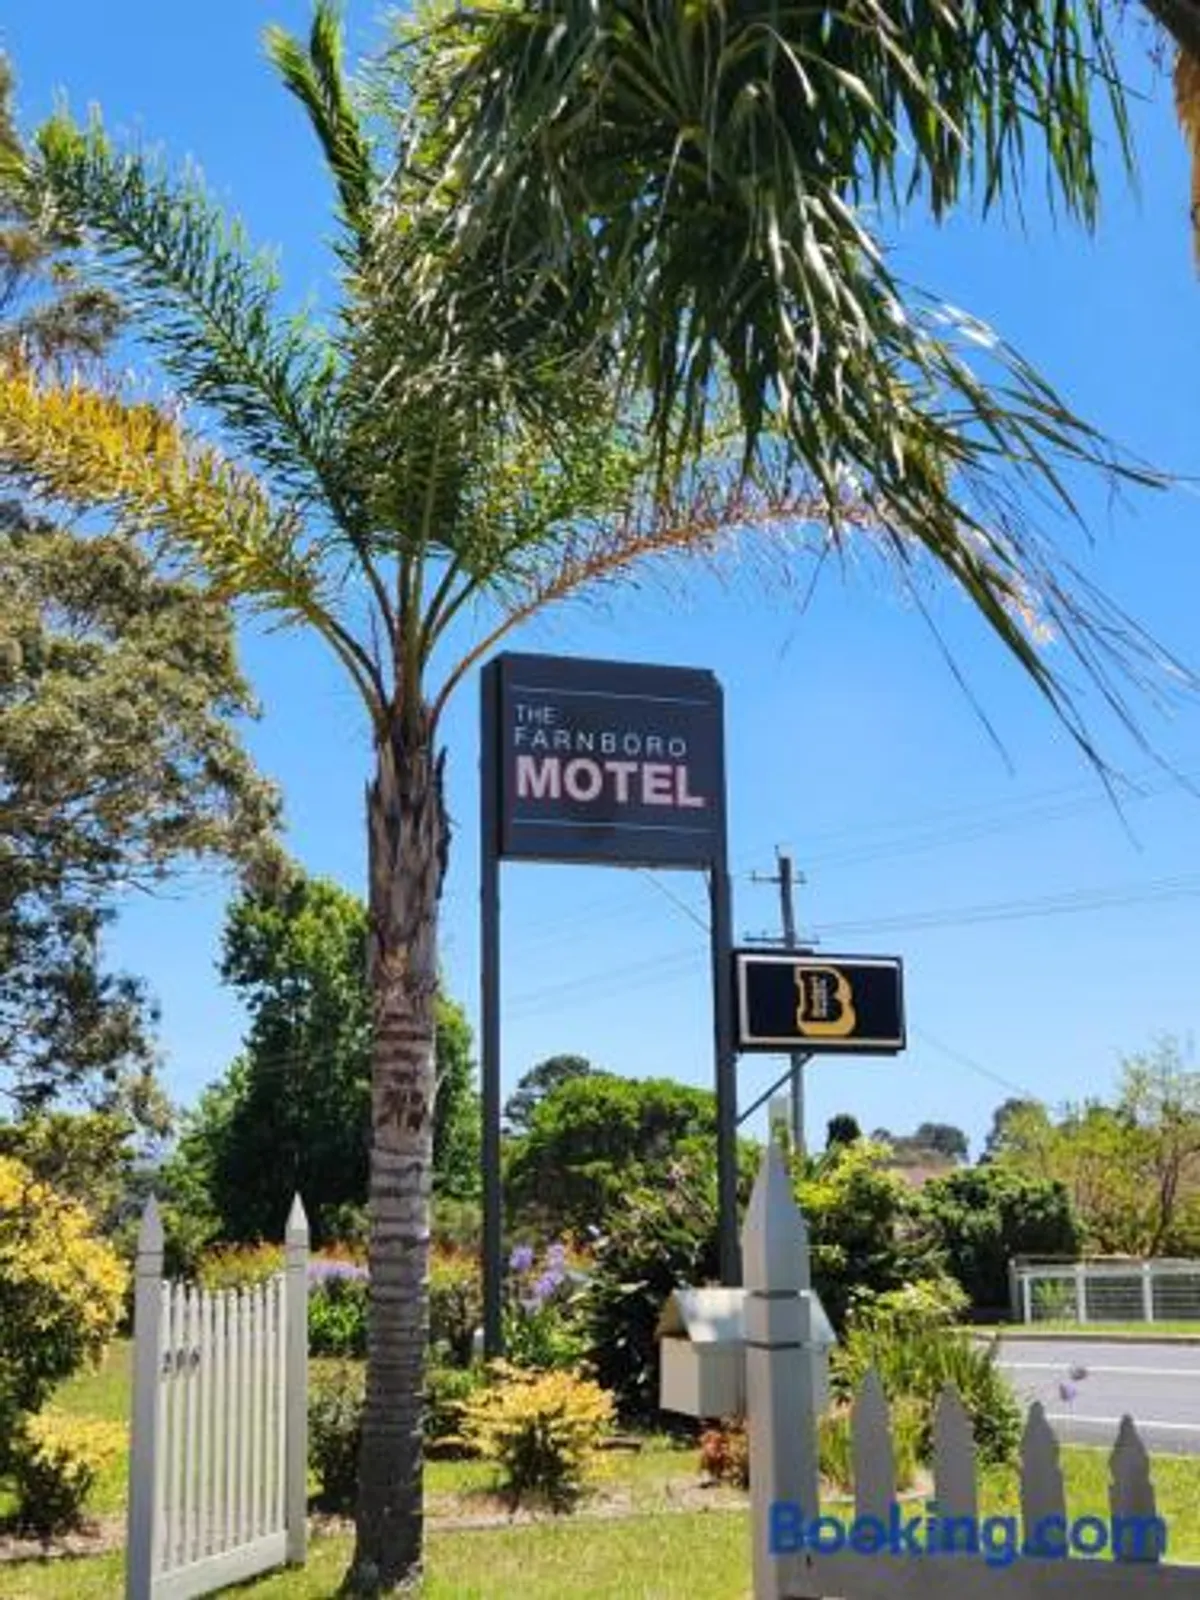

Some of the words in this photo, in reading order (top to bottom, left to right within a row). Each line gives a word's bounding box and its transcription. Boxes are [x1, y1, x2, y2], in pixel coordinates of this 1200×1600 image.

[514, 704, 557, 724] THE
[513, 726, 686, 757] FARNBORO
[516, 755, 705, 807] MOTEL
